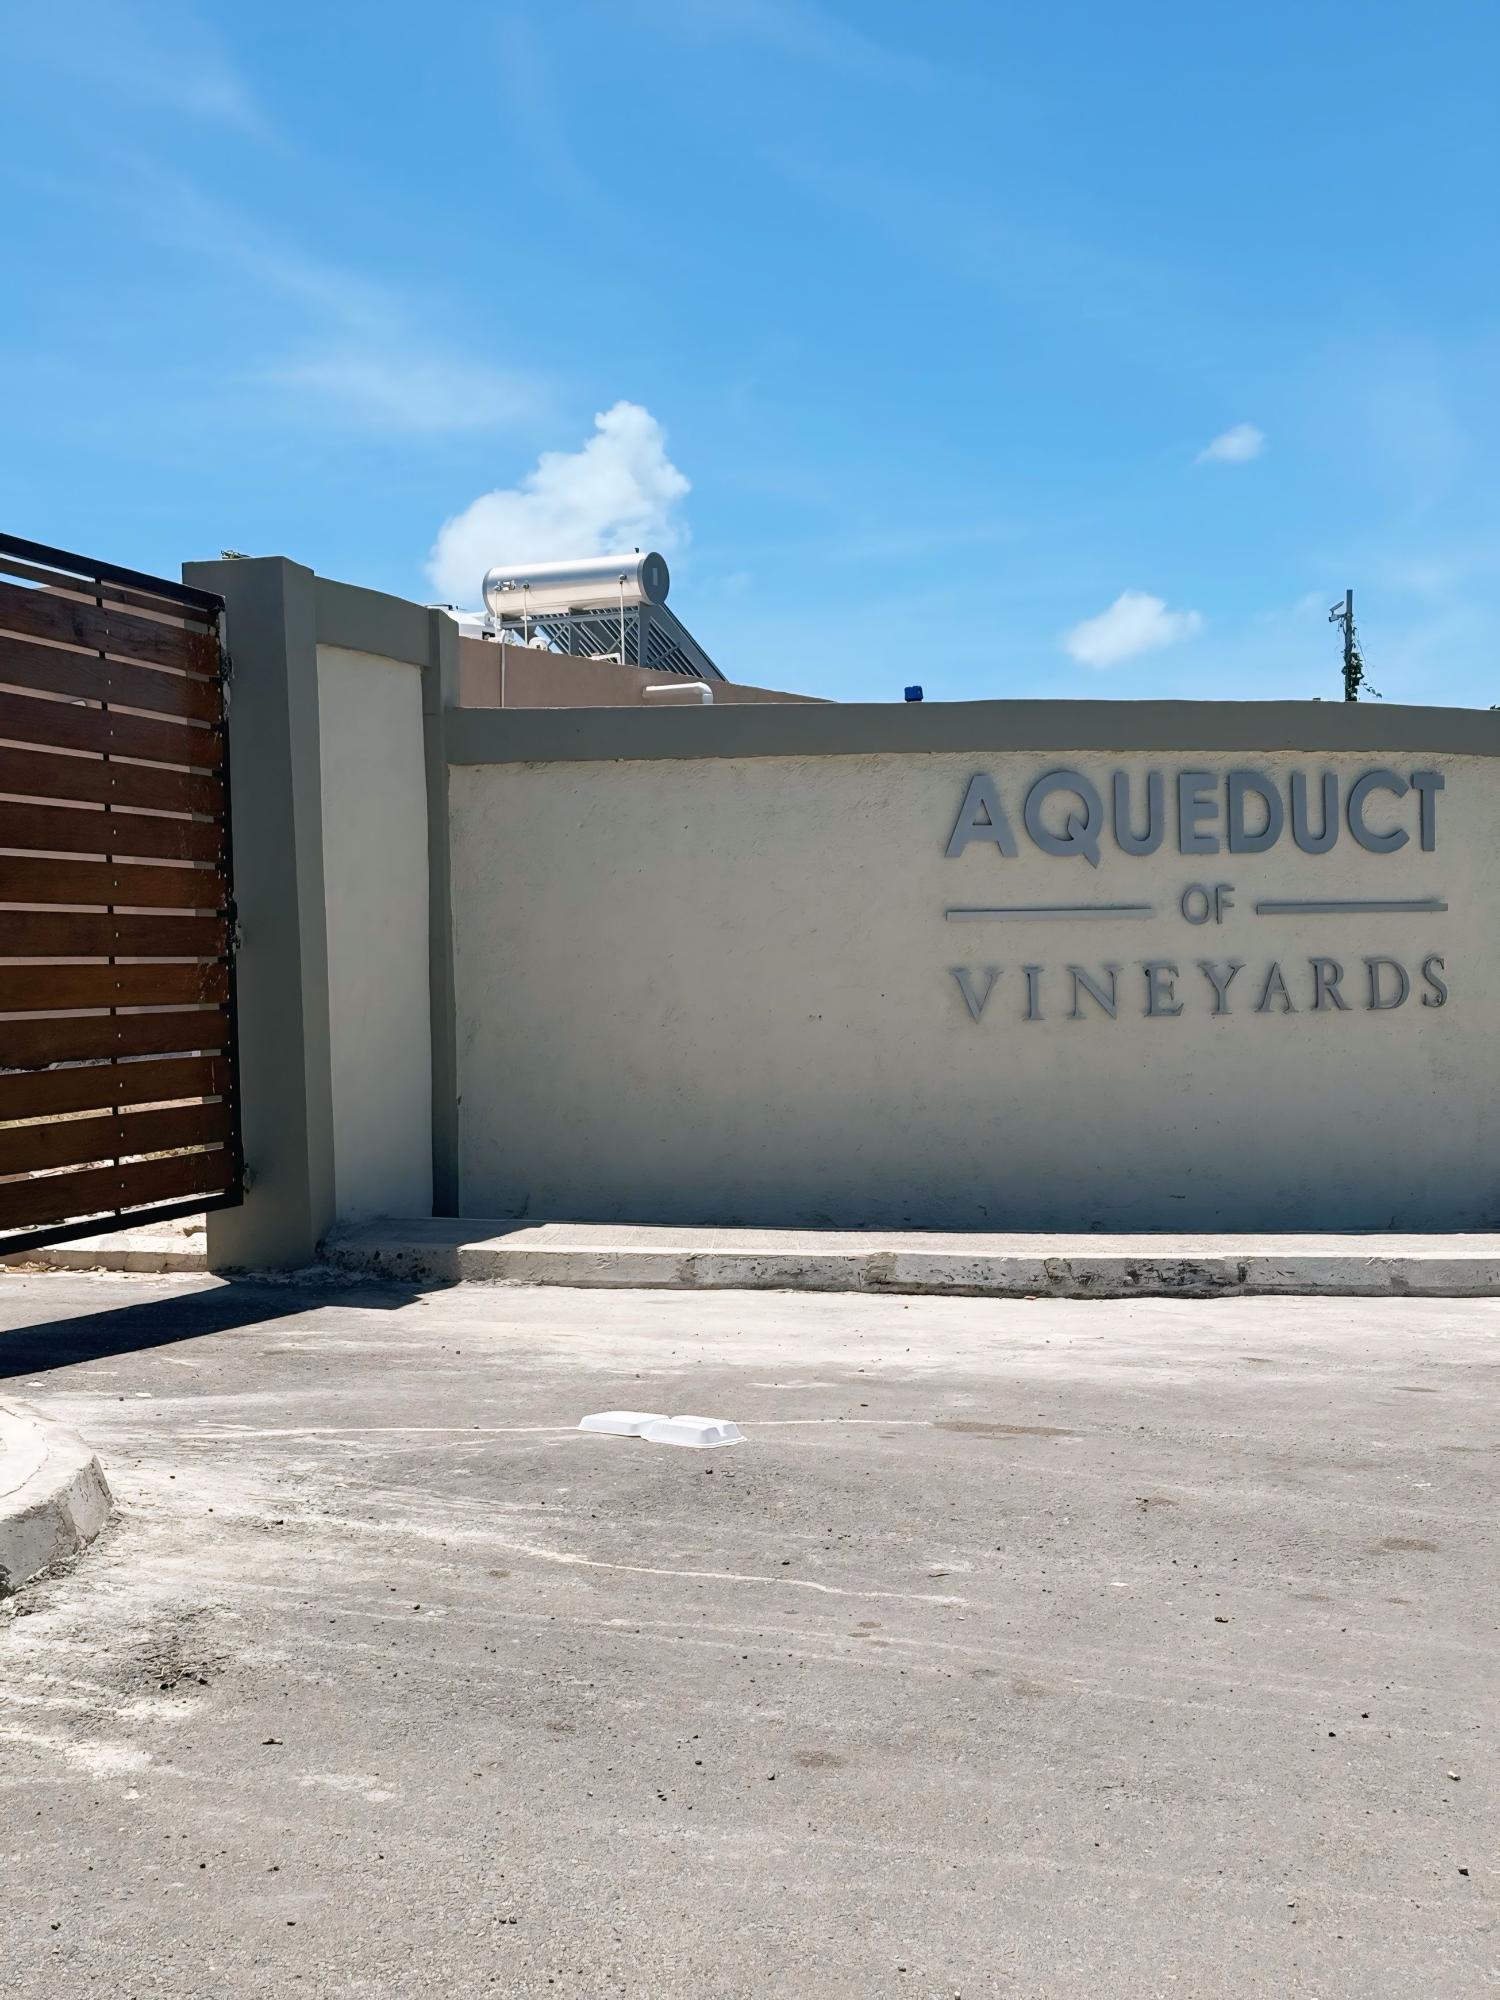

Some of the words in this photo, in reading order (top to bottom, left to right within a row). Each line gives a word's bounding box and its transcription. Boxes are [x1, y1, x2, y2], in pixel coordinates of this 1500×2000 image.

[944, 769, 1445, 868] AQUEDUCT
[1181, 883, 1236, 925] OF
[949, 954, 1449, 1024] VINEYARDS
